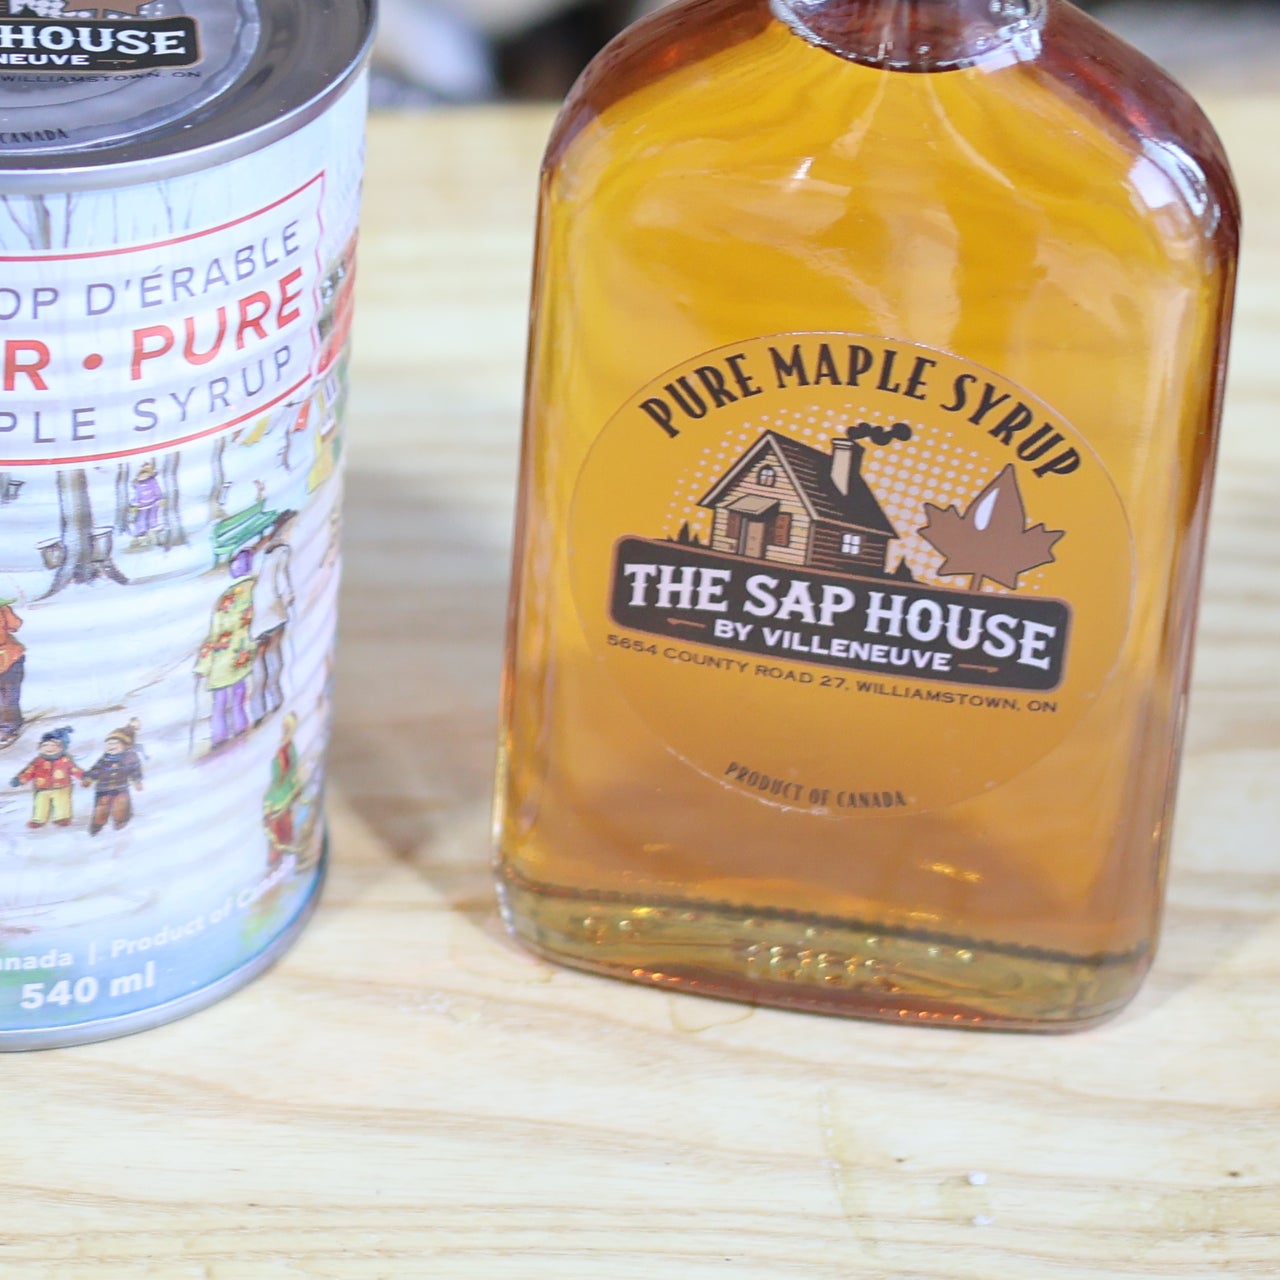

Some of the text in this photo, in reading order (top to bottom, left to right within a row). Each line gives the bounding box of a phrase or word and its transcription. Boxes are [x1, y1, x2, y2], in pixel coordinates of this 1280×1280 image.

[171, 70, 203, 79] ON
[85, 220, 300, 315] D'ÉRABLE
[131, 268, 305, 380] PURE
[133, 345, 294, 433] SYRUP
[638, 344, 1082, 478] PURE MAPLE SYRUP
[623, 563, 1057, 670] THE SAP HOUSE
[713, 620, 952, 671] BY VILLENEUVE
[606, 634, 658, 655] 5654
[663, 647, 749, 673] COUNTY
[755, 665, 813, 684] ROAD
[1027, 700, 1057, 713] ON
[724, 761, 907, 808] PRODUCT OF CANADA
[111, 916, 205, 959] Product
[20, 961, 156, 1011] 540 ml
